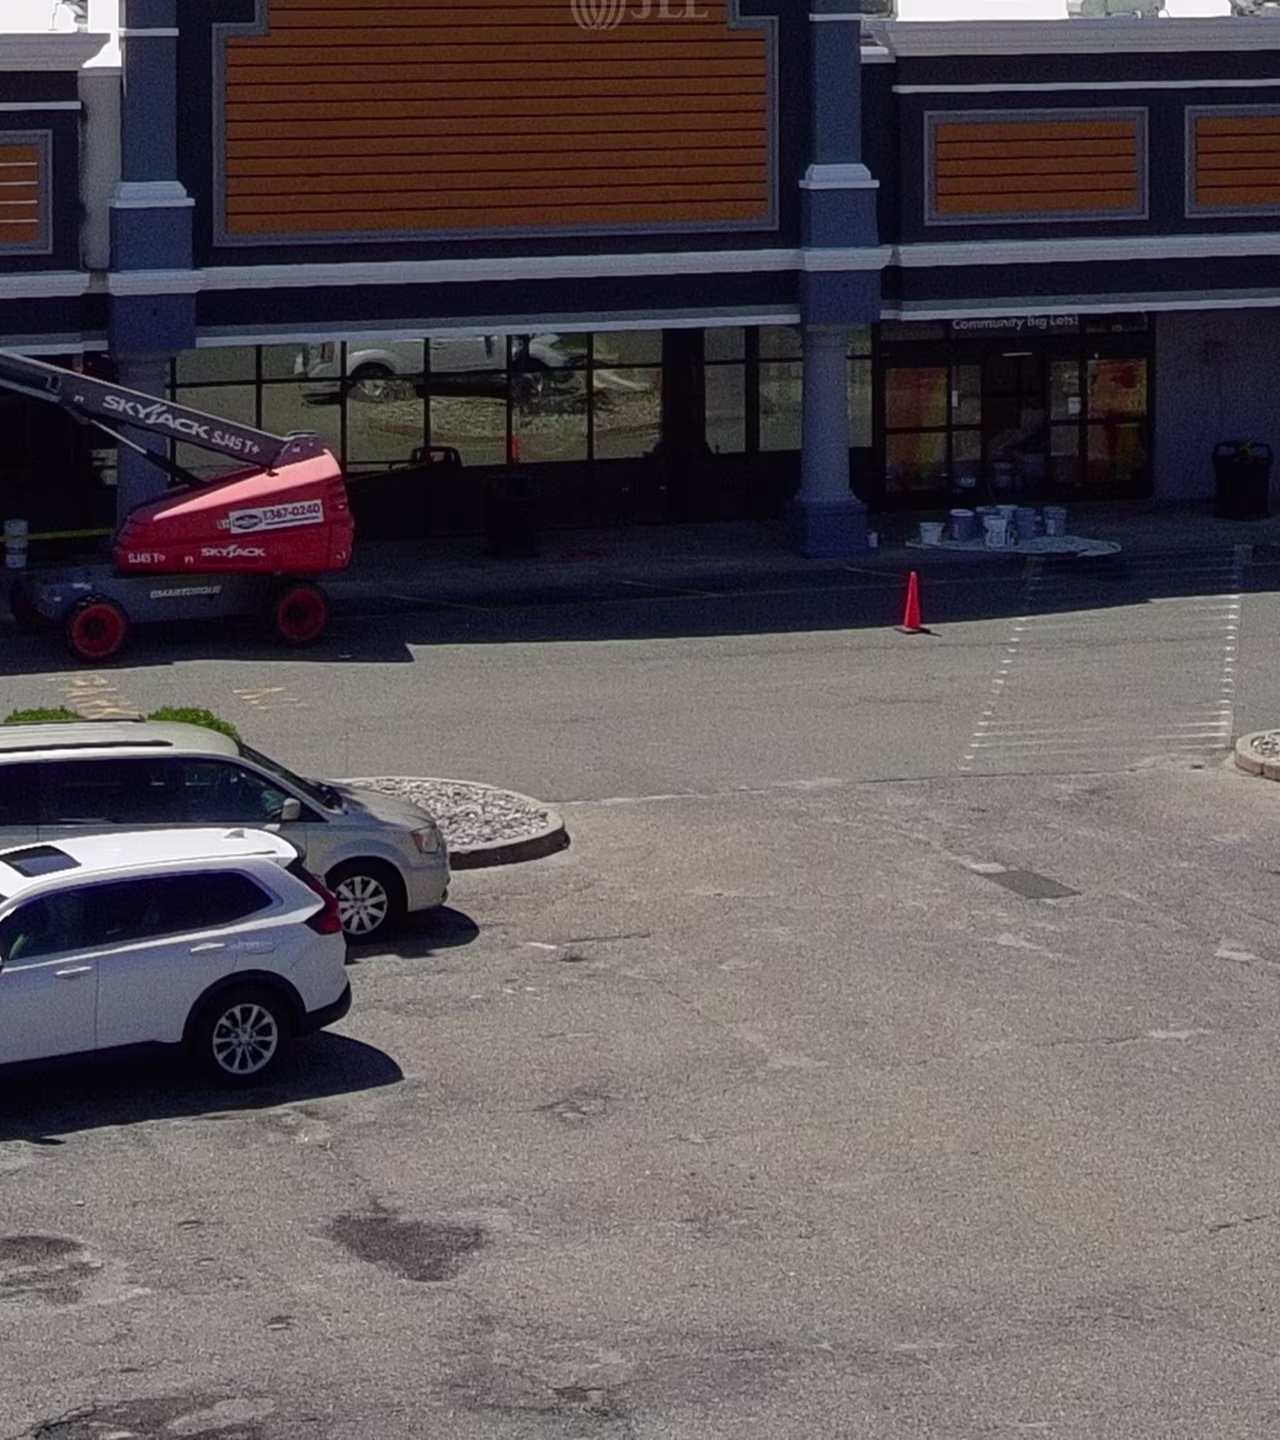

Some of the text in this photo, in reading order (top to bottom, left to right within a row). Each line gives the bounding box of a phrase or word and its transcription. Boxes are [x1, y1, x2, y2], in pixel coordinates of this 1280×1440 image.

[952, 317, 1024, 331] Community
[103, 395, 210, 439] SKYJACK
[211, 430, 243, 452] SJ45
[201, 544, 266, 558] SKYJACK
